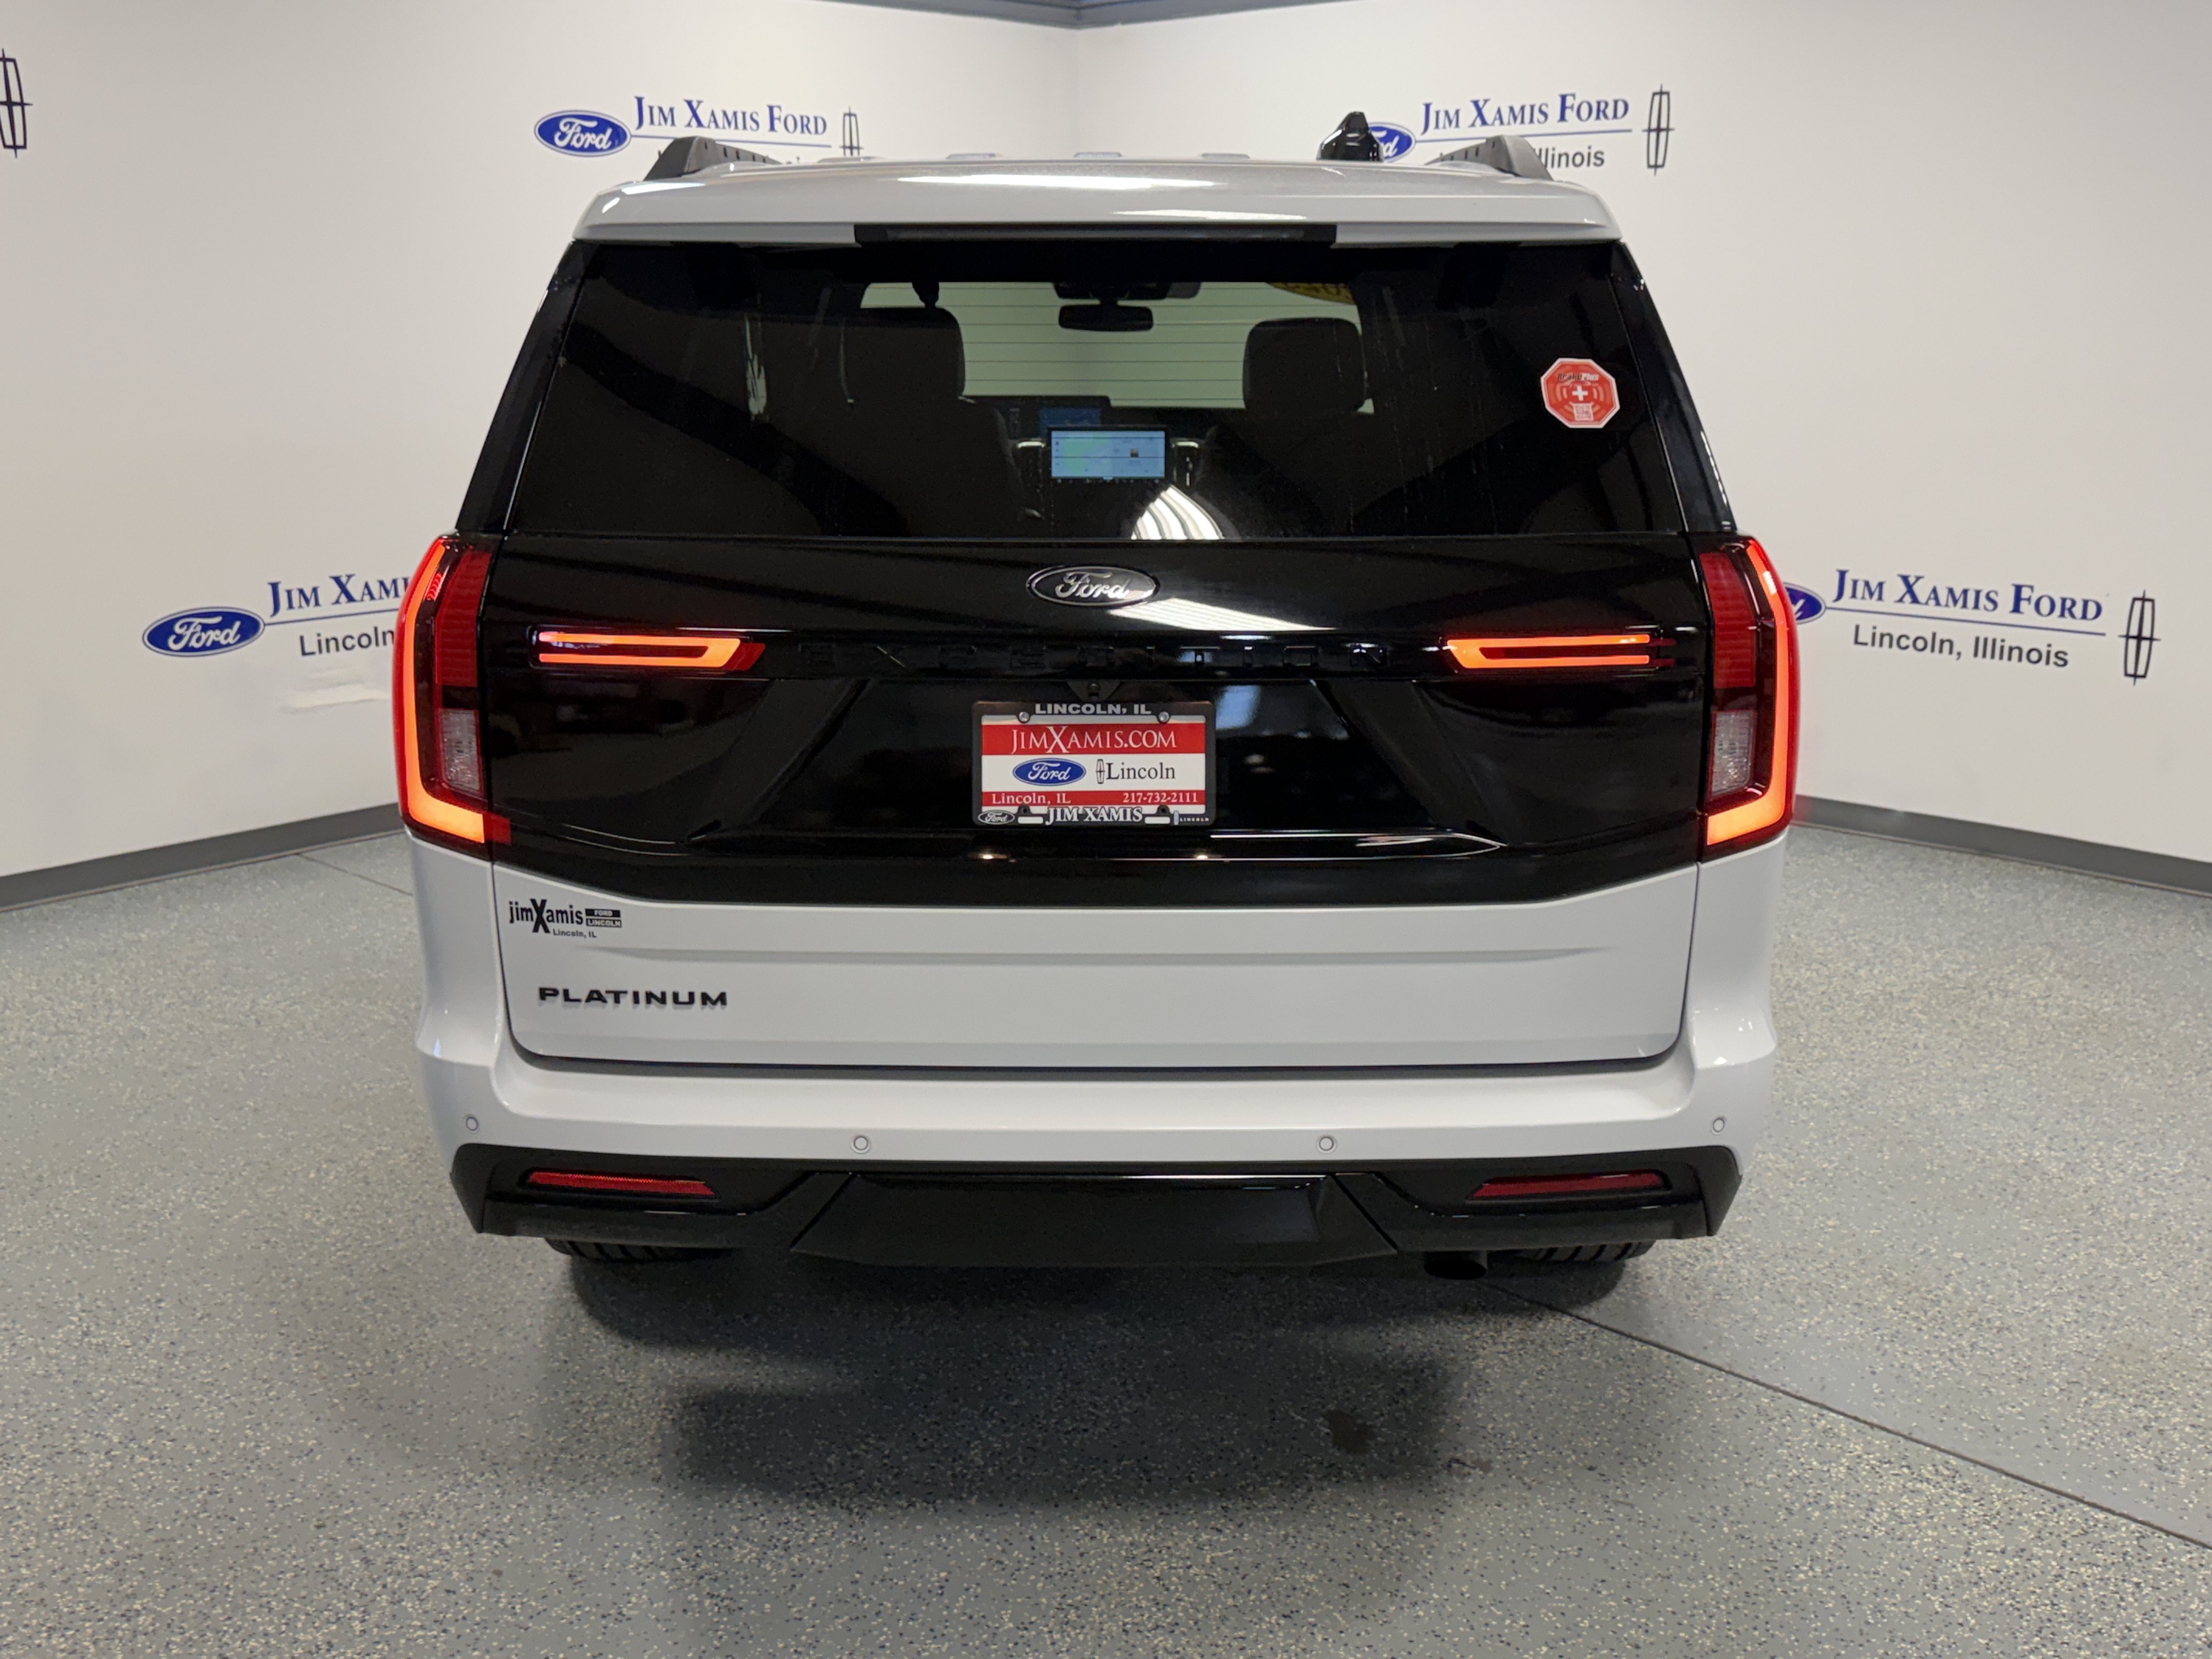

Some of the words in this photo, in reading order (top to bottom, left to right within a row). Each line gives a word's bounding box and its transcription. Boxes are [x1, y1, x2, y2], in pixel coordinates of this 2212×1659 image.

[634, 96, 675, 131] JIM
[684, 99, 760, 132] XAMIS
[766, 104, 827, 136] FORD
[1421, 102, 1460, 136] JIM
[1469, 98, 1548, 127] XAMIS
[1558, 93, 1629, 122] FORD
[1533, 145, 1605, 168] llinois
[268, 581, 320, 617] JIM
[330, 574, 410, 605] XAMI
[1055, 571, 1131, 599] Ford
[1832, 569, 1884, 603] JIM
[1894, 573, 1999, 613] XAMIS
[2010, 583, 2103, 622] FORD
[1853, 623, 1962, 661] Lincoln,
[1973, 636, 2069, 668] Illinois
[1035, 703, 1127, 715] LINCOLN,
[1133, 704, 1152, 714] IL
[1105, 762, 1176, 780] Lincoln
[992, 793, 1051, 805] Lincoln,
[1056, 793, 1071, 804] IL
[1122, 792, 1198, 804] 217-732-2111
[1045, 806, 1082, 825] JIM
[1085, 806, 1143, 822] XAMIS
[553, 928, 586, 939] Lincoln,
[539, 987, 727, 1006] PLATINUM
